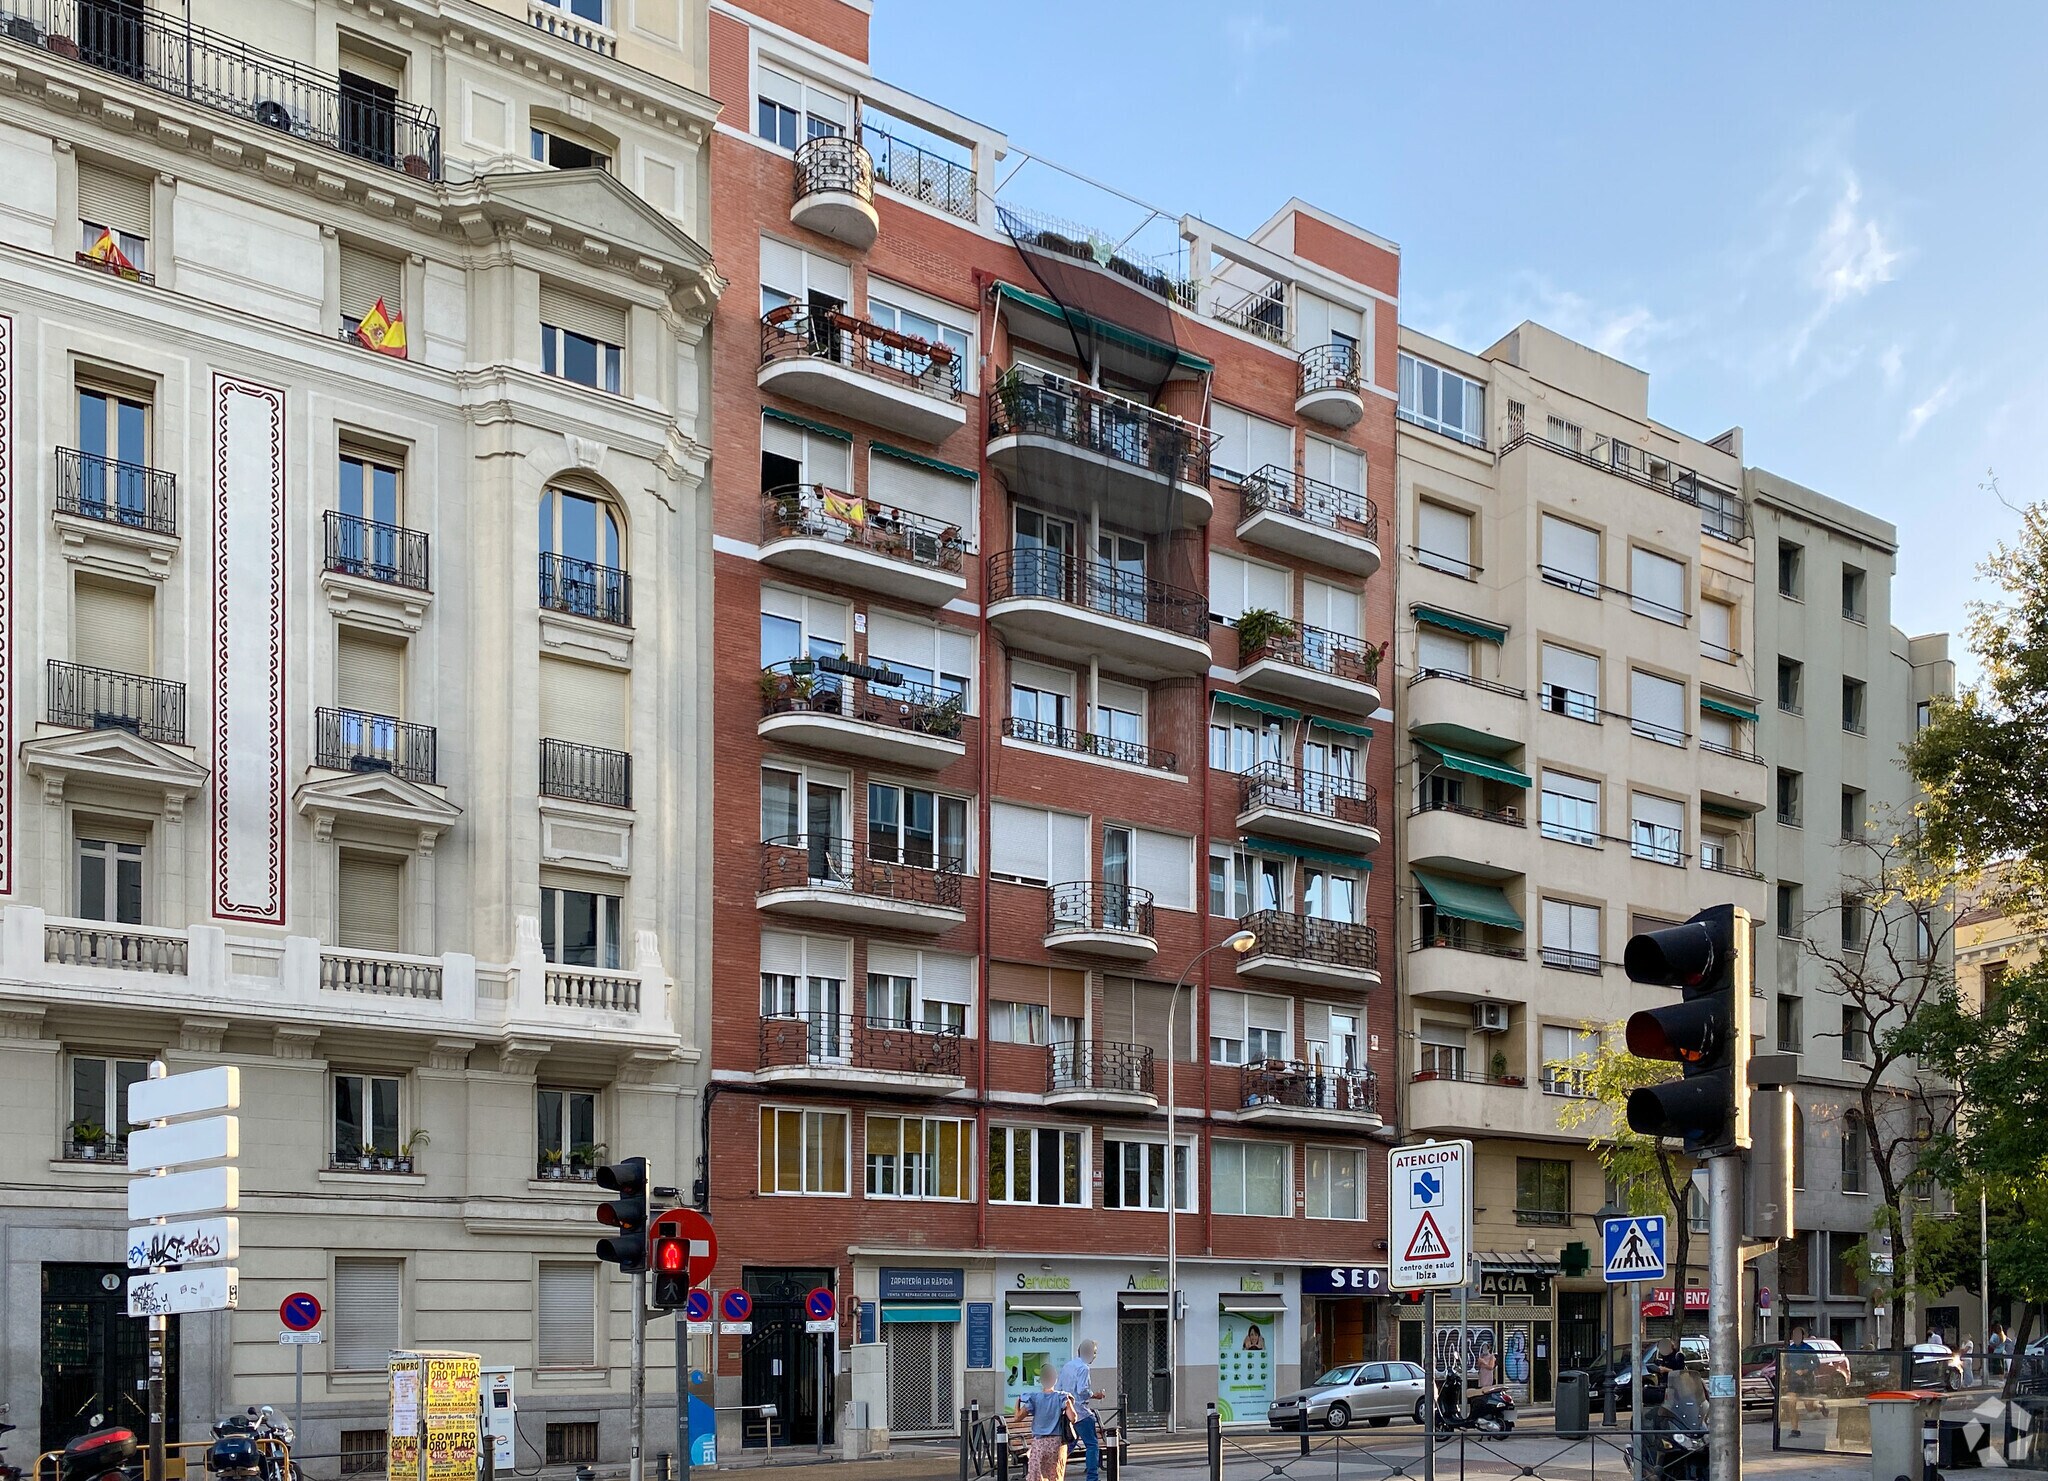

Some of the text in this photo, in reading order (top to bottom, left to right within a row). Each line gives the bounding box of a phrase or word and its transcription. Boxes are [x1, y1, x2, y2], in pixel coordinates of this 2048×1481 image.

[1396, 1150, 1459, 1168] ATENCION
[1400, 1263, 1422, 1272] centro
[1435, 1261, 1455, 1269] salud
[1416, 1271, 1437, 1280] Ibiza
[890, 1276, 922, 1286] ZAPATERÍA
[922, 1277, 930, 1286] LA
[1016, 1273, 1070, 1289] Servicios
[1008, 1325, 1054, 1333] Centro Auditivo
[391, 1362, 419, 1371] COMPRO
[431, 1362, 476, 1370] COMPRO
[429, 1432, 476, 1440] COMPRO
